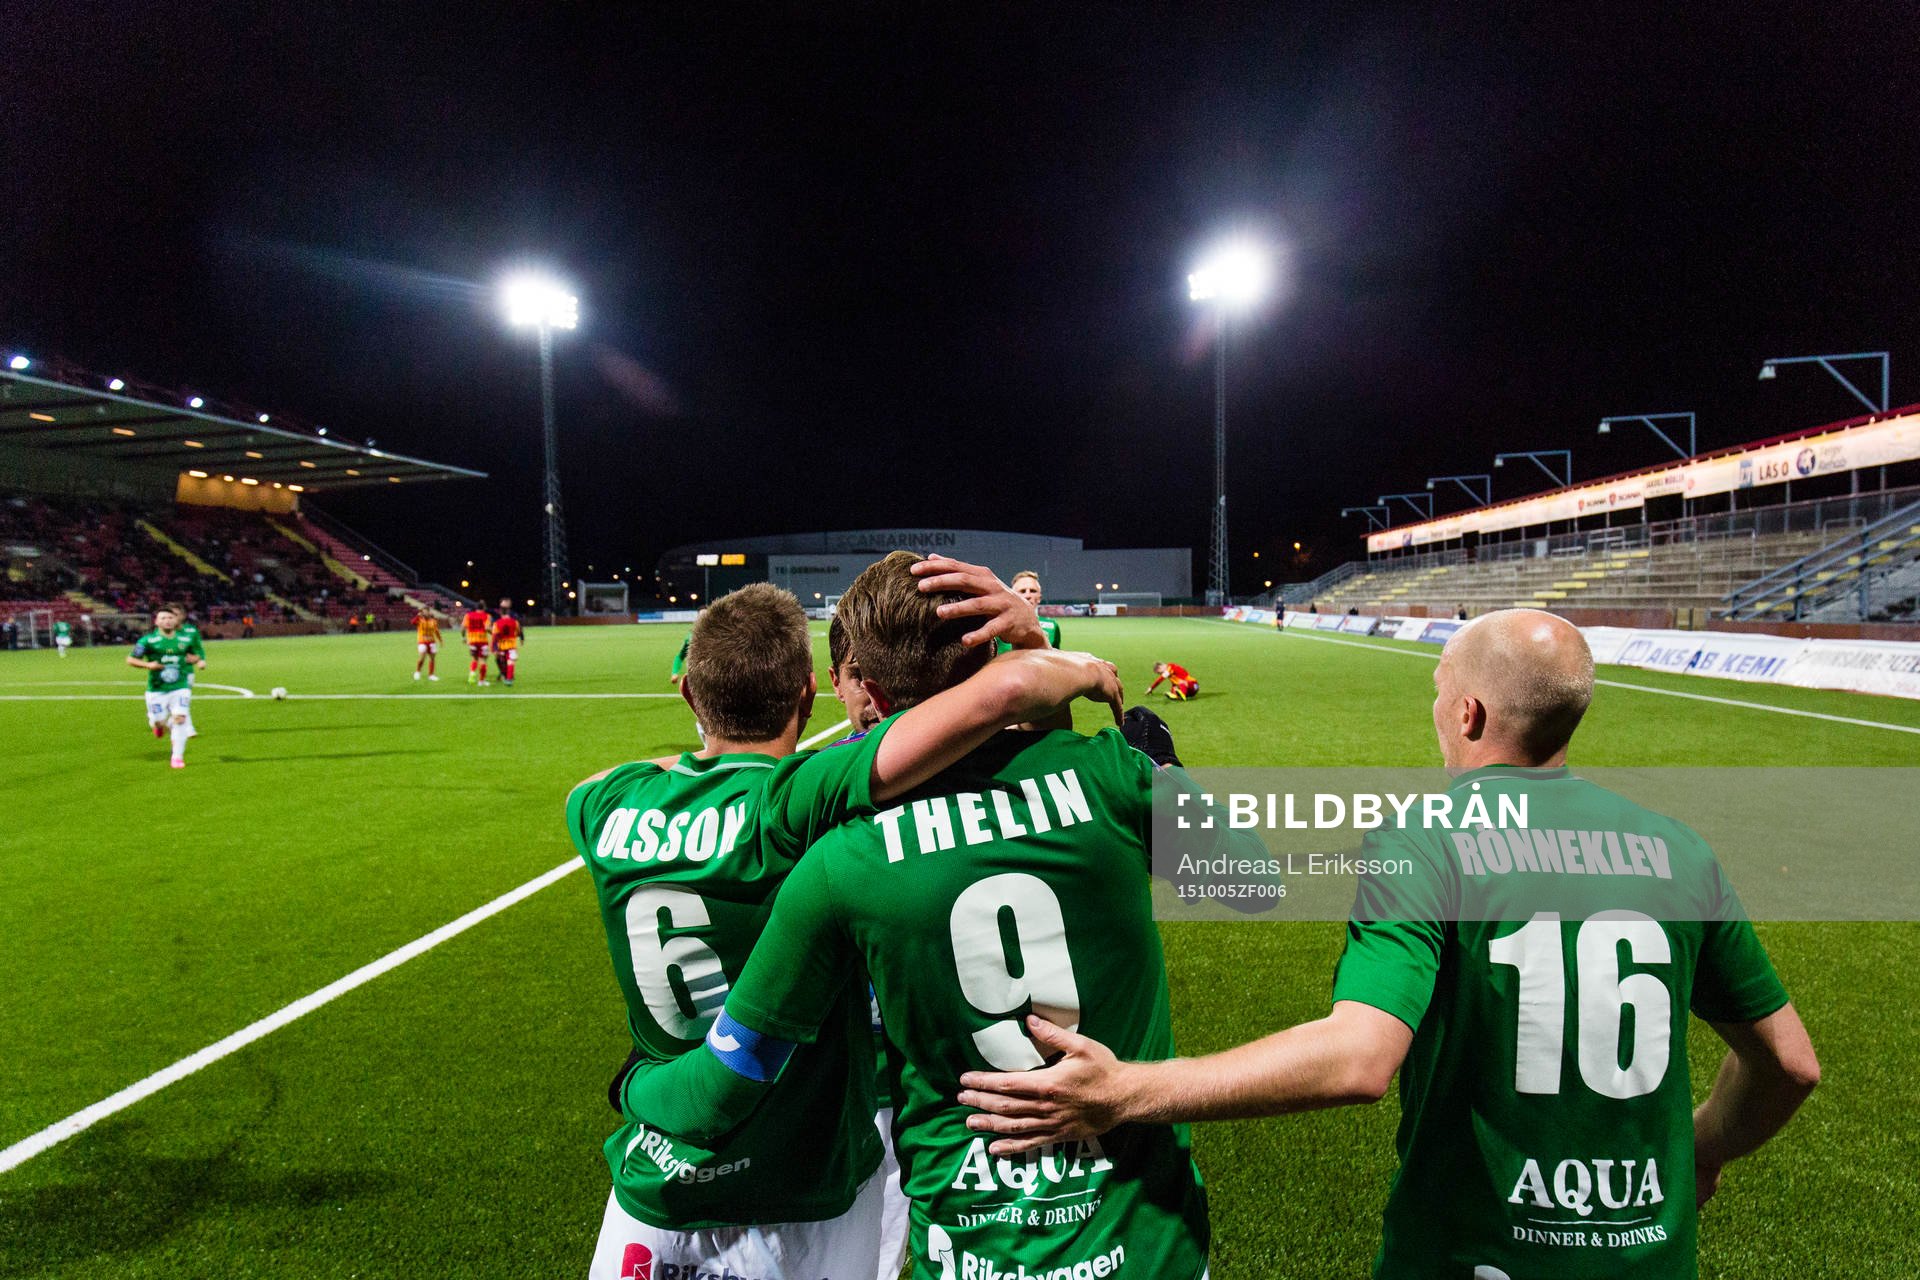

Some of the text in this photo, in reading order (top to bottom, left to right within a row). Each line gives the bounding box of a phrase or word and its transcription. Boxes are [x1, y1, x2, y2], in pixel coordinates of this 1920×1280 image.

[1644, 648, 1720, 669] AKSAB
[1719, 652, 1787, 676] KEMI
[596, 801, 746, 863] OLSSON
[873, 768, 1093, 864] THELIN
[1450, 823, 1673, 880] RÖNNEKLEV
[625, 883, 729, 1040] 6
[949, 872, 1081, 1072] 9
[1488, 909, 1672, 1100] 16
[951, 1137, 1114, 1196] AQUA
[1507, 1157, 1665, 1217] AQUA
[1027, 1208, 1041, 1227] &
[1512, 1224, 1667, 1248] DINNER & DRINKS
